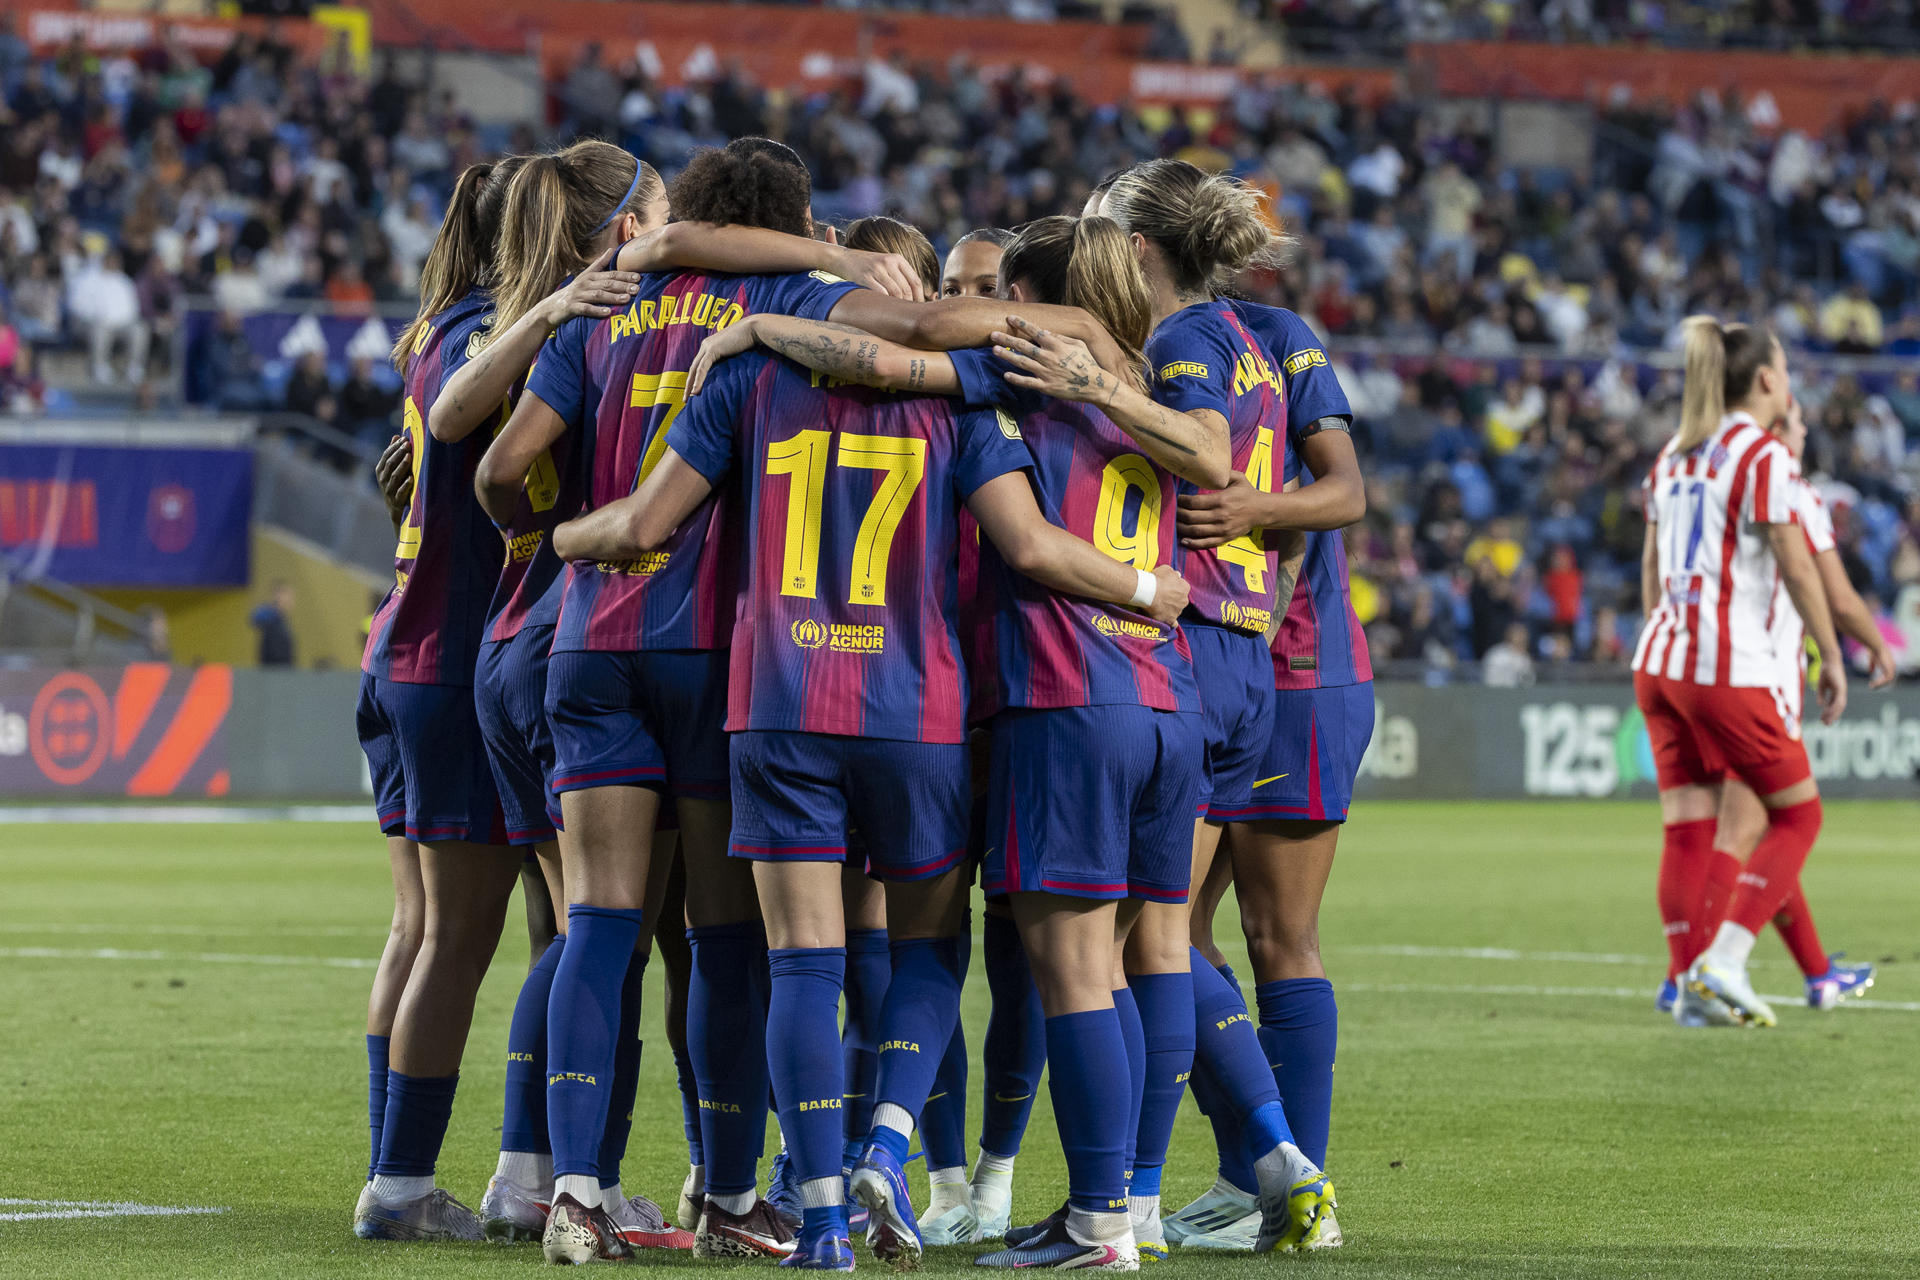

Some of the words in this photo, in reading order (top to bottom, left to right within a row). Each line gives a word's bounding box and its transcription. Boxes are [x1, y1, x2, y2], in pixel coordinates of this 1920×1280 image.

[611, 291, 744, 344] PARALLUEO
[1161, 363, 1208, 378] BIMBO
[1285, 351, 1327, 374] BIMBO
[630, 371, 688, 490] 7
[766, 429, 927, 606] 17
[1093, 453, 1162, 573] 9
[509, 530, 544, 550] UNHC
[513, 542, 539, 561] ACN
[1241, 606, 1271, 623] UNHCR
[830, 624, 885, 637] UNHCR
[1120, 620, 1160, 637] UNHCR
[829, 635, 884, 648] ACNUR
[1520, 701, 1618, 798] 125
